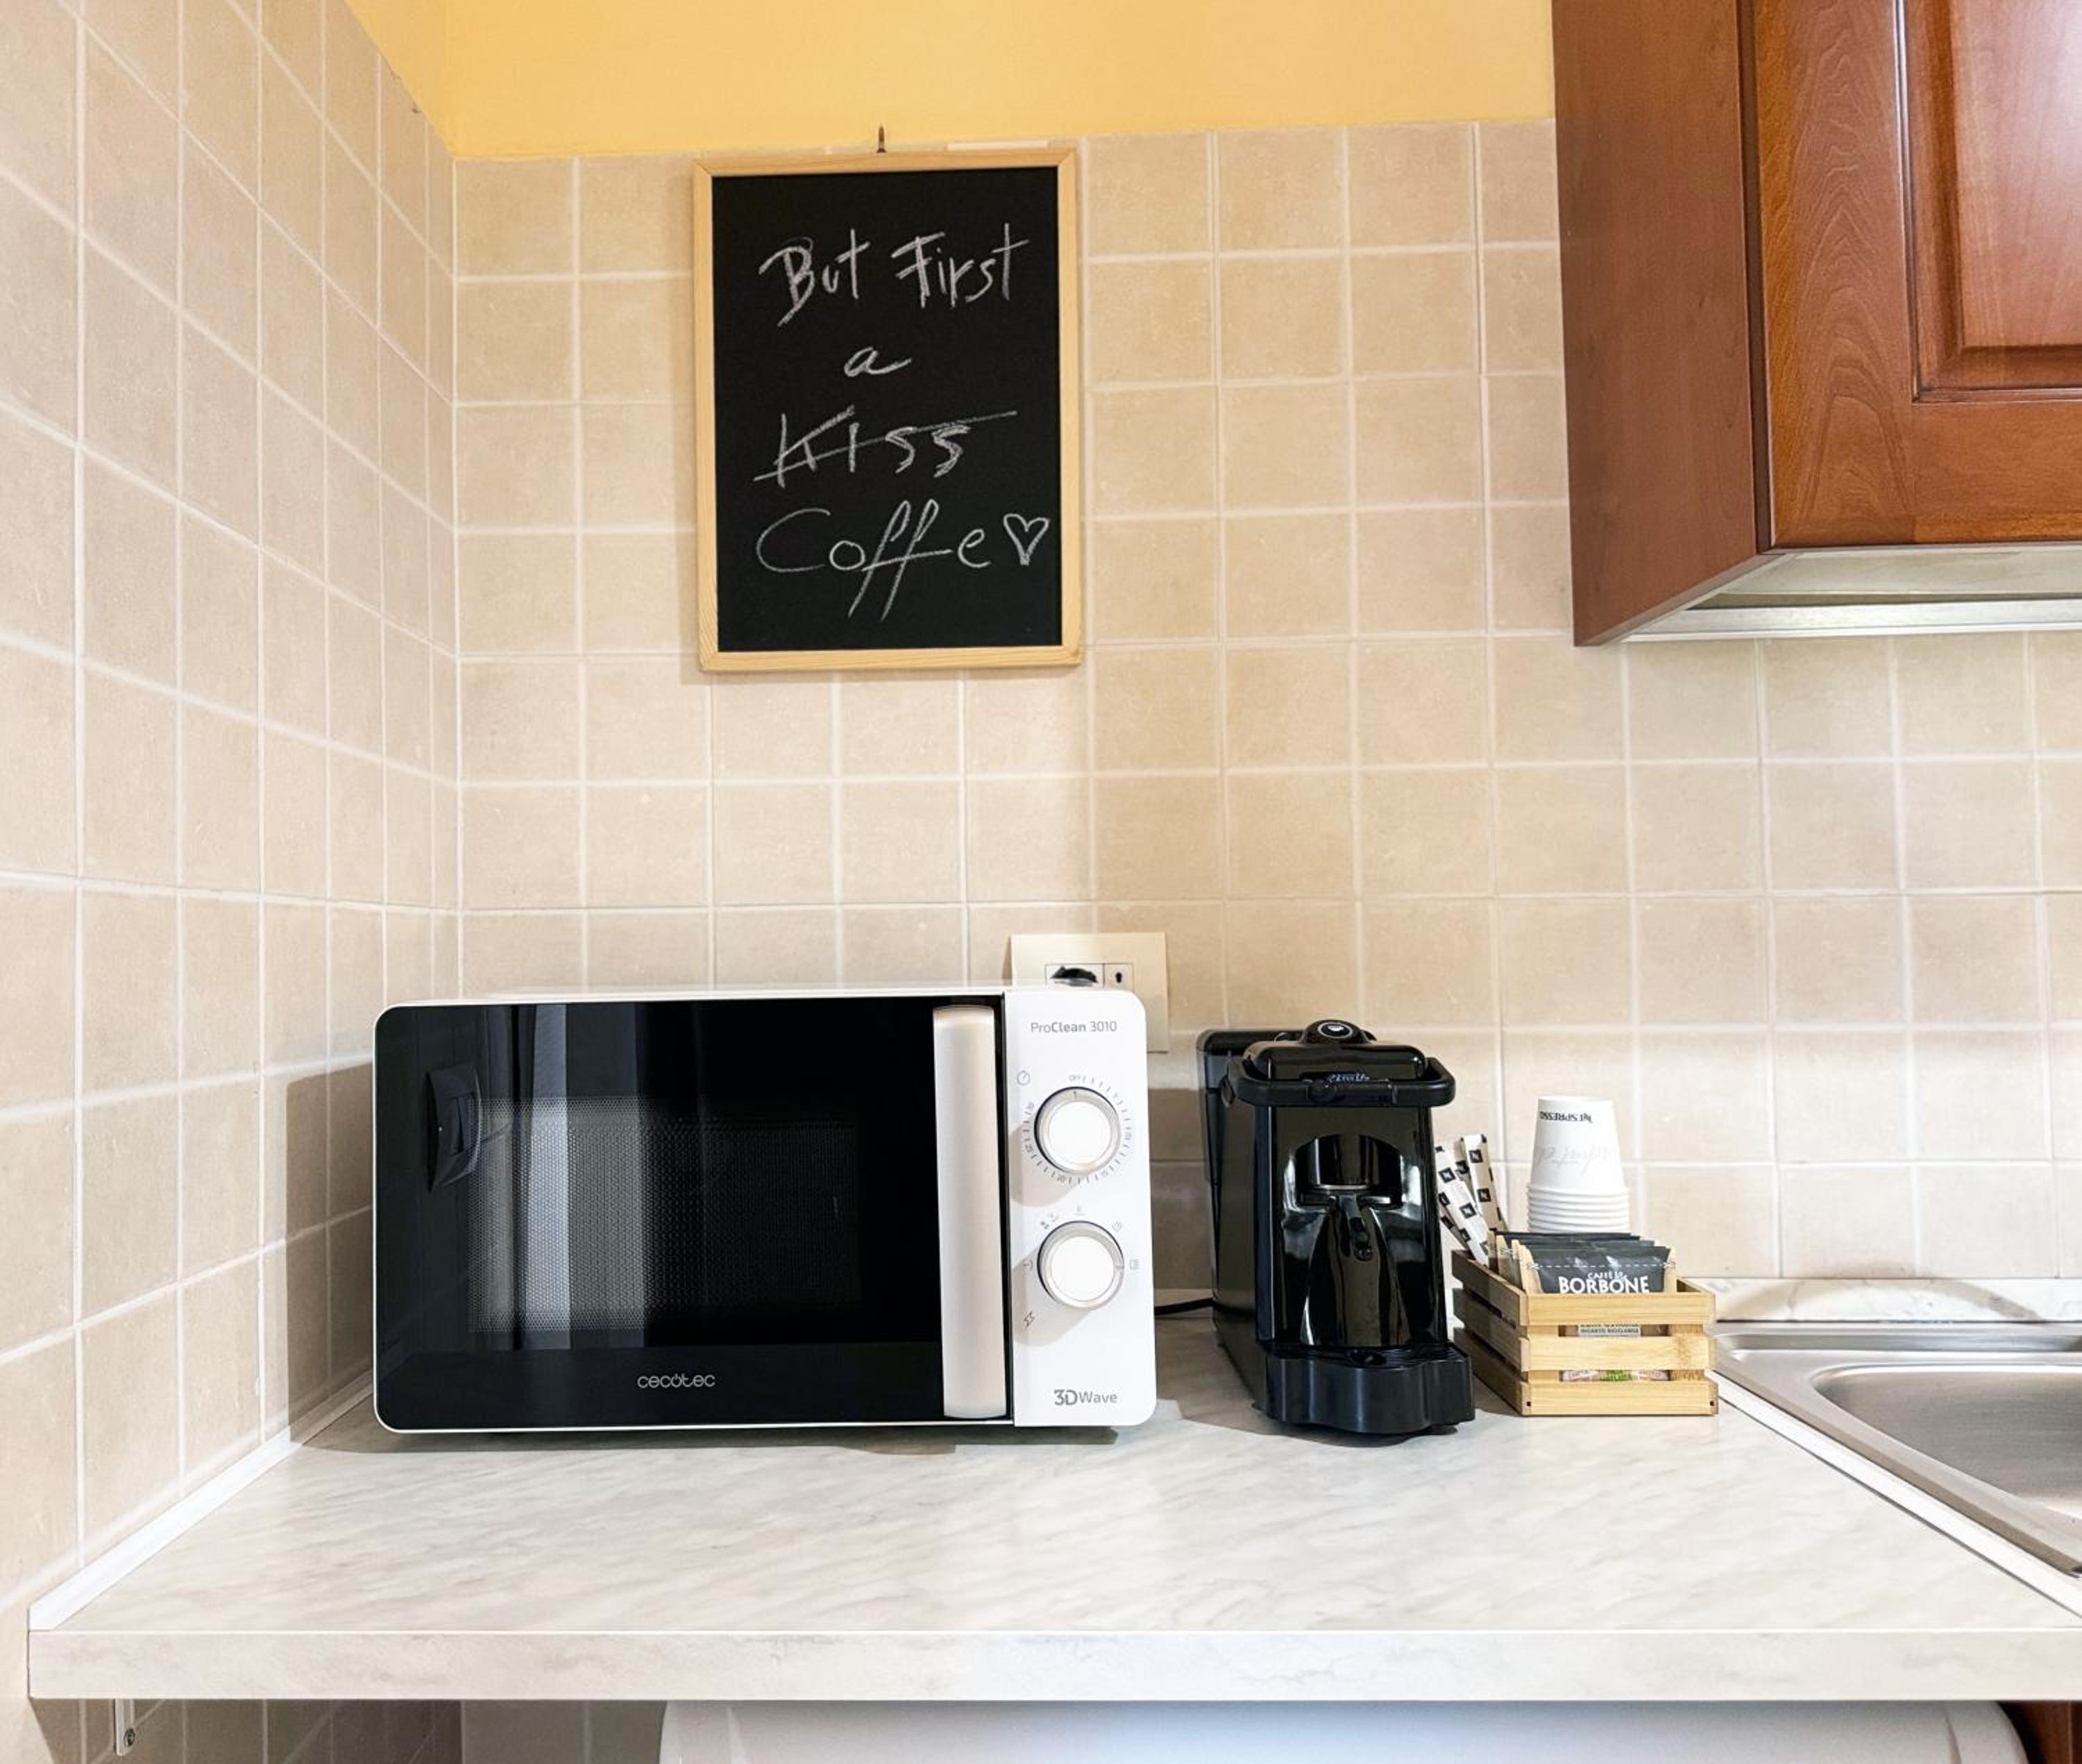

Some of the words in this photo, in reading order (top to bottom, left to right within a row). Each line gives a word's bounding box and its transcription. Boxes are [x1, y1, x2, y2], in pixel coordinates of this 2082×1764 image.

[758, 228, 871, 327] But
[890, 222, 1030, 309] First
[843, 346, 913, 378] a
[755, 498, 991, 620] Coffe
[1031, 1020, 1087, 1033] ProClean
[1090, 1020, 1117, 1033] 3010
[1558, 1275, 1650, 1294] BORBONE
[637, 1373, 716, 1389] cecotec
